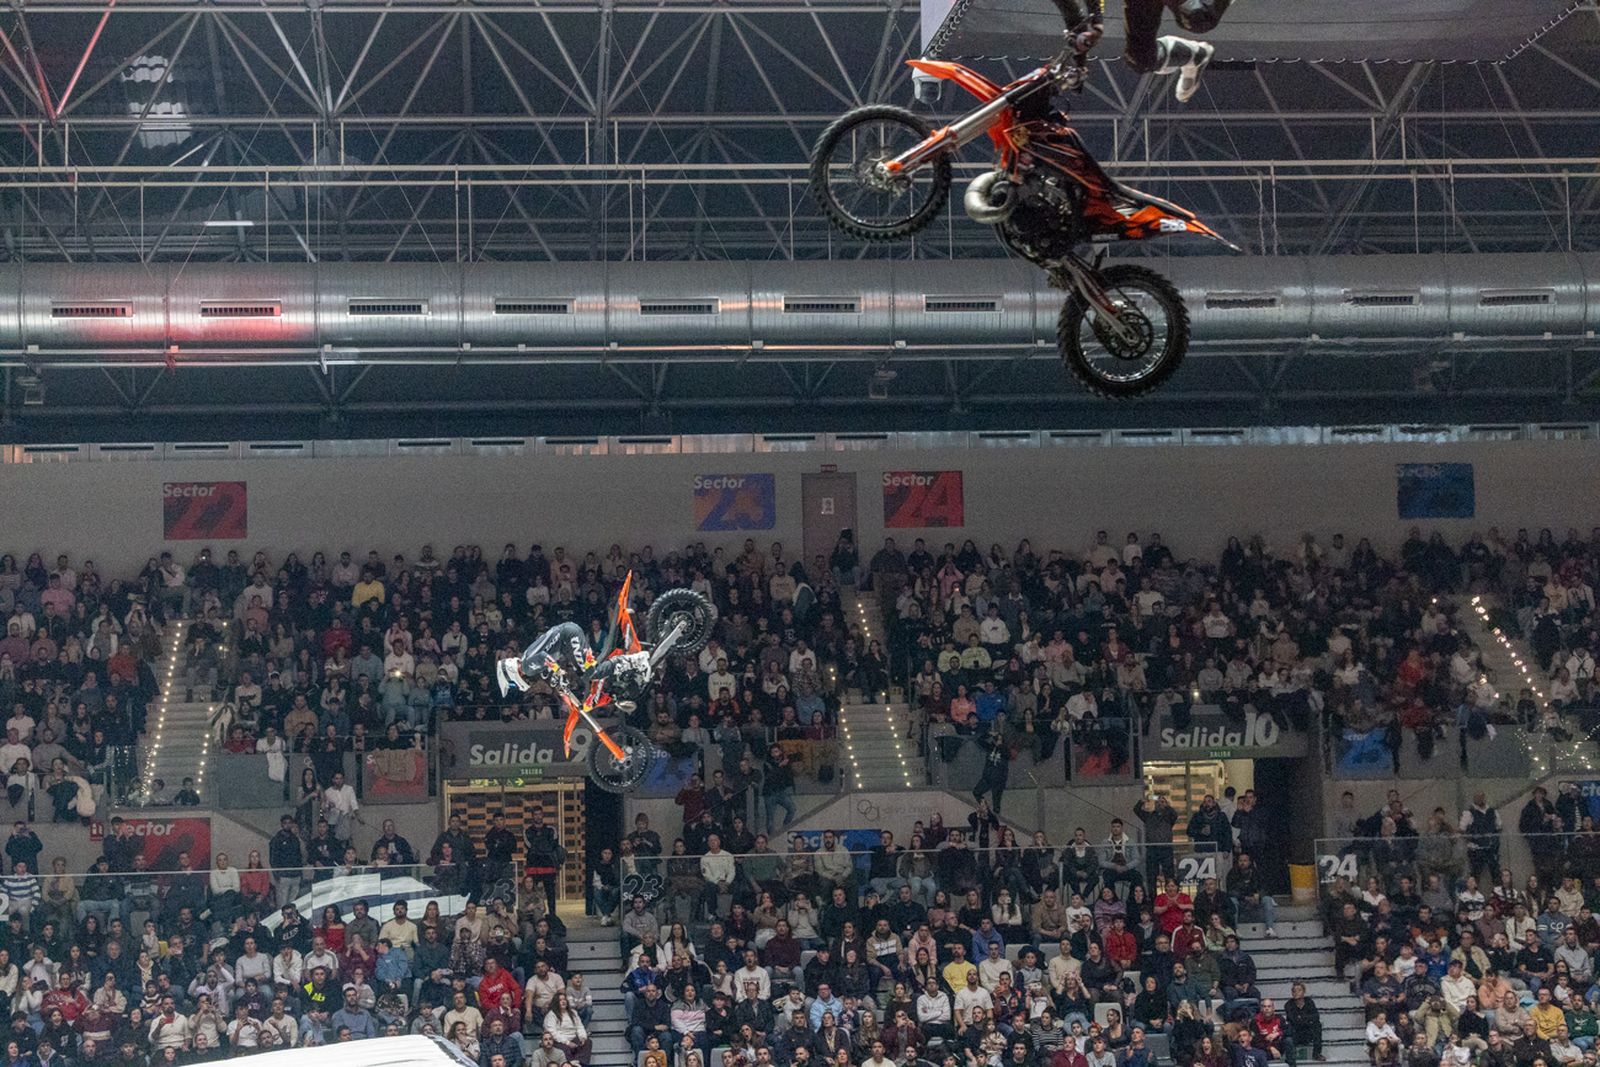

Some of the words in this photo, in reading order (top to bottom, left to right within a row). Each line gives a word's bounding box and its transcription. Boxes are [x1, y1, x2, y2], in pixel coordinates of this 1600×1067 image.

[694, 475, 746, 489] Sector
[882, 472, 933, 486] Sector
[164, 483, 216, 497] Sector
[1161, 726, 1241, 748] Salida
[1244, 708, 1279, 747] 10
[470, 742, 554, 765] Salida
[568, 728, 593, 763] 9
[127, 821, 175, 836] ector
[1178, 857, 1217, 880] 24
[1318, 854, 1359, 882] 24
